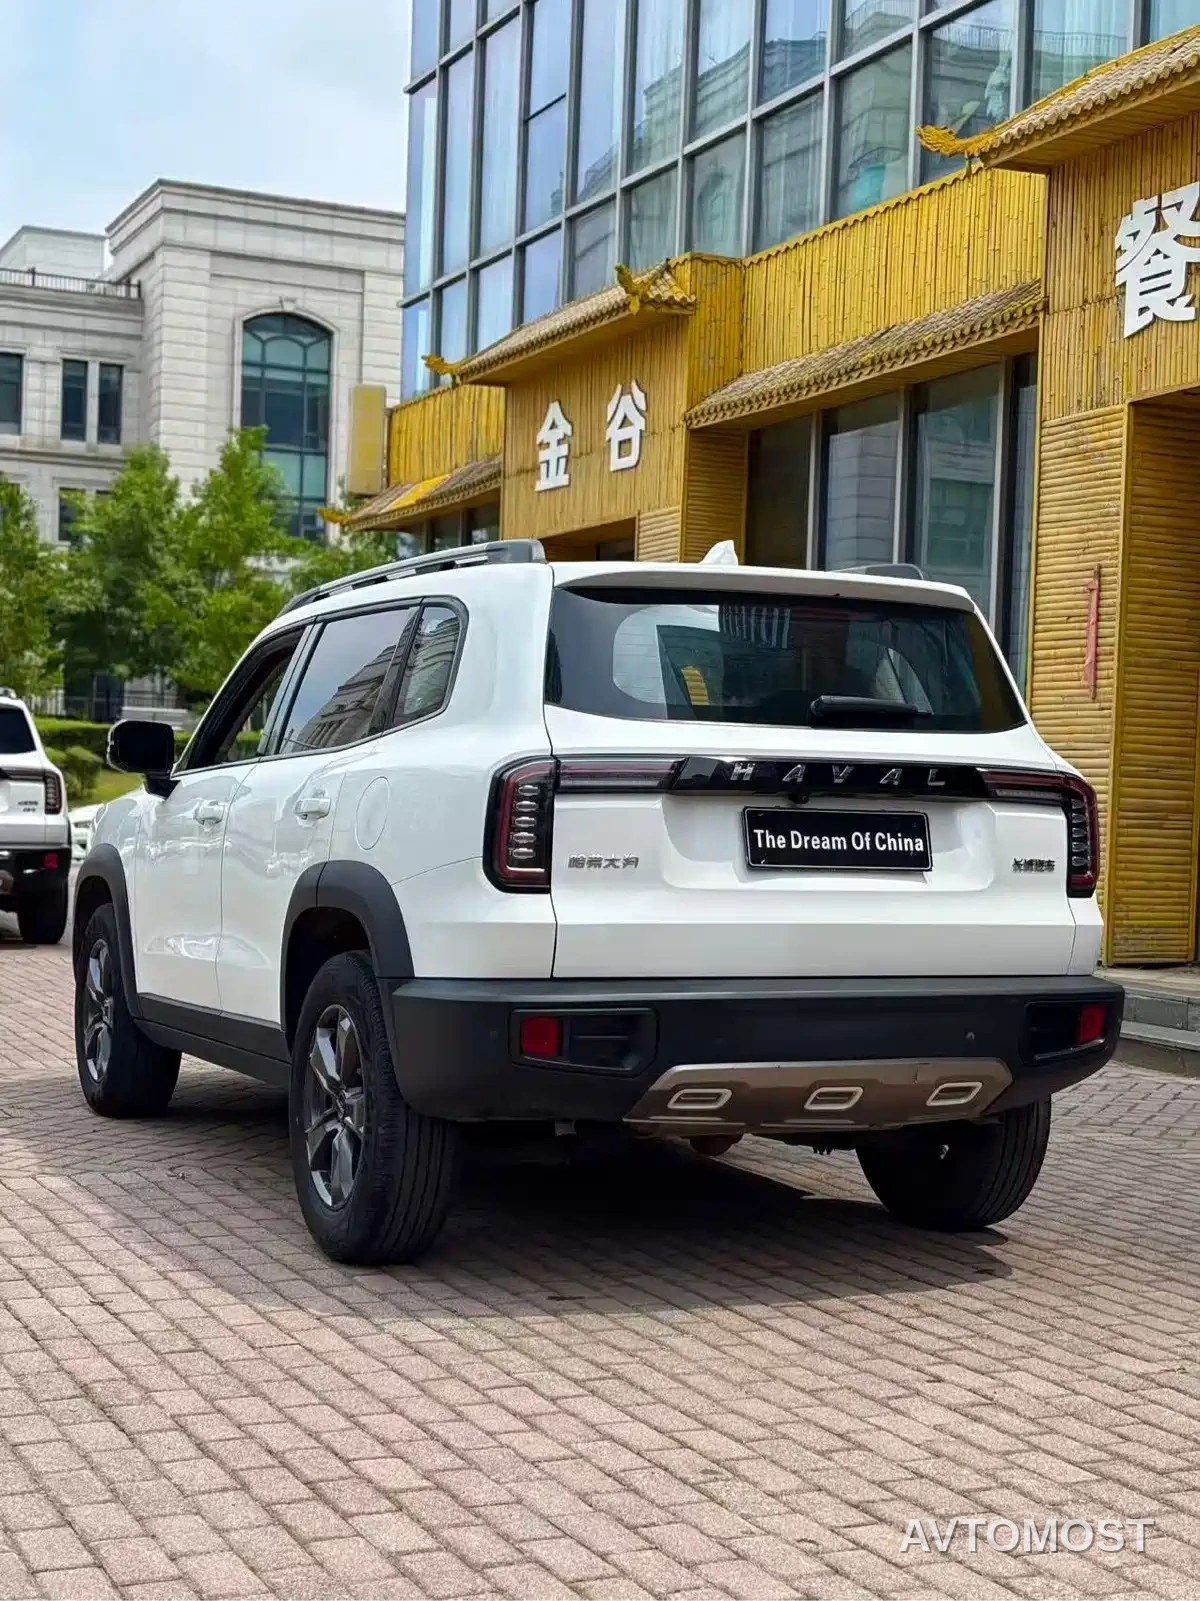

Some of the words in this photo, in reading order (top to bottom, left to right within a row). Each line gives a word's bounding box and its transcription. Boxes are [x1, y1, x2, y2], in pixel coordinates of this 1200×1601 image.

[1115, 180, 1200, 338] 餐
[535, 379, 647, 492] 金谷
[730, 762, 946, 786] HAVAL
[753, 829, 787, 849] The
[790, 830, 848, 851] Dream
[851, 831, 872, 851] Of
[874, 832, 924, 852] China
